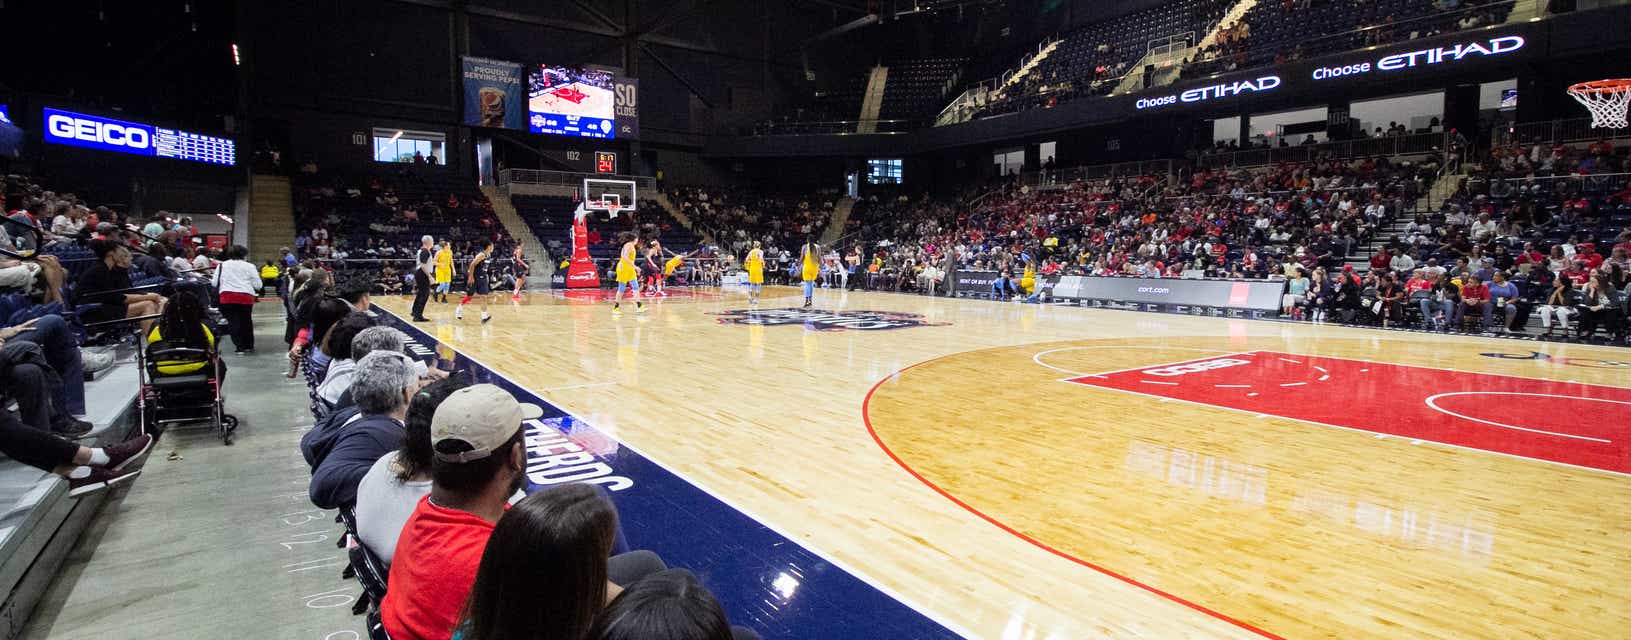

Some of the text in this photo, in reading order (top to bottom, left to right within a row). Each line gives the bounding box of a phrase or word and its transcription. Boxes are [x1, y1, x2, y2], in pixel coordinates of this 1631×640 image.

[1312, 35, 1525, 81] Choose ETIHAD
[464, 71, 498, 81] SERVING
[473, 66, 511, 77] PROUDLY
[615, 83, 636, 107] SO
[1135, 75, 1281, 110] Choose ETIHAD
[616, 106, 637, 118] CLOSE
[48, 114, 149, 149] GEICO
[352, 134, 367, 145] 101
[566, 151, 580, 161] 102
[600, 160, 612, 172] 24
[1137, 286, 1170, 294] cort.com
